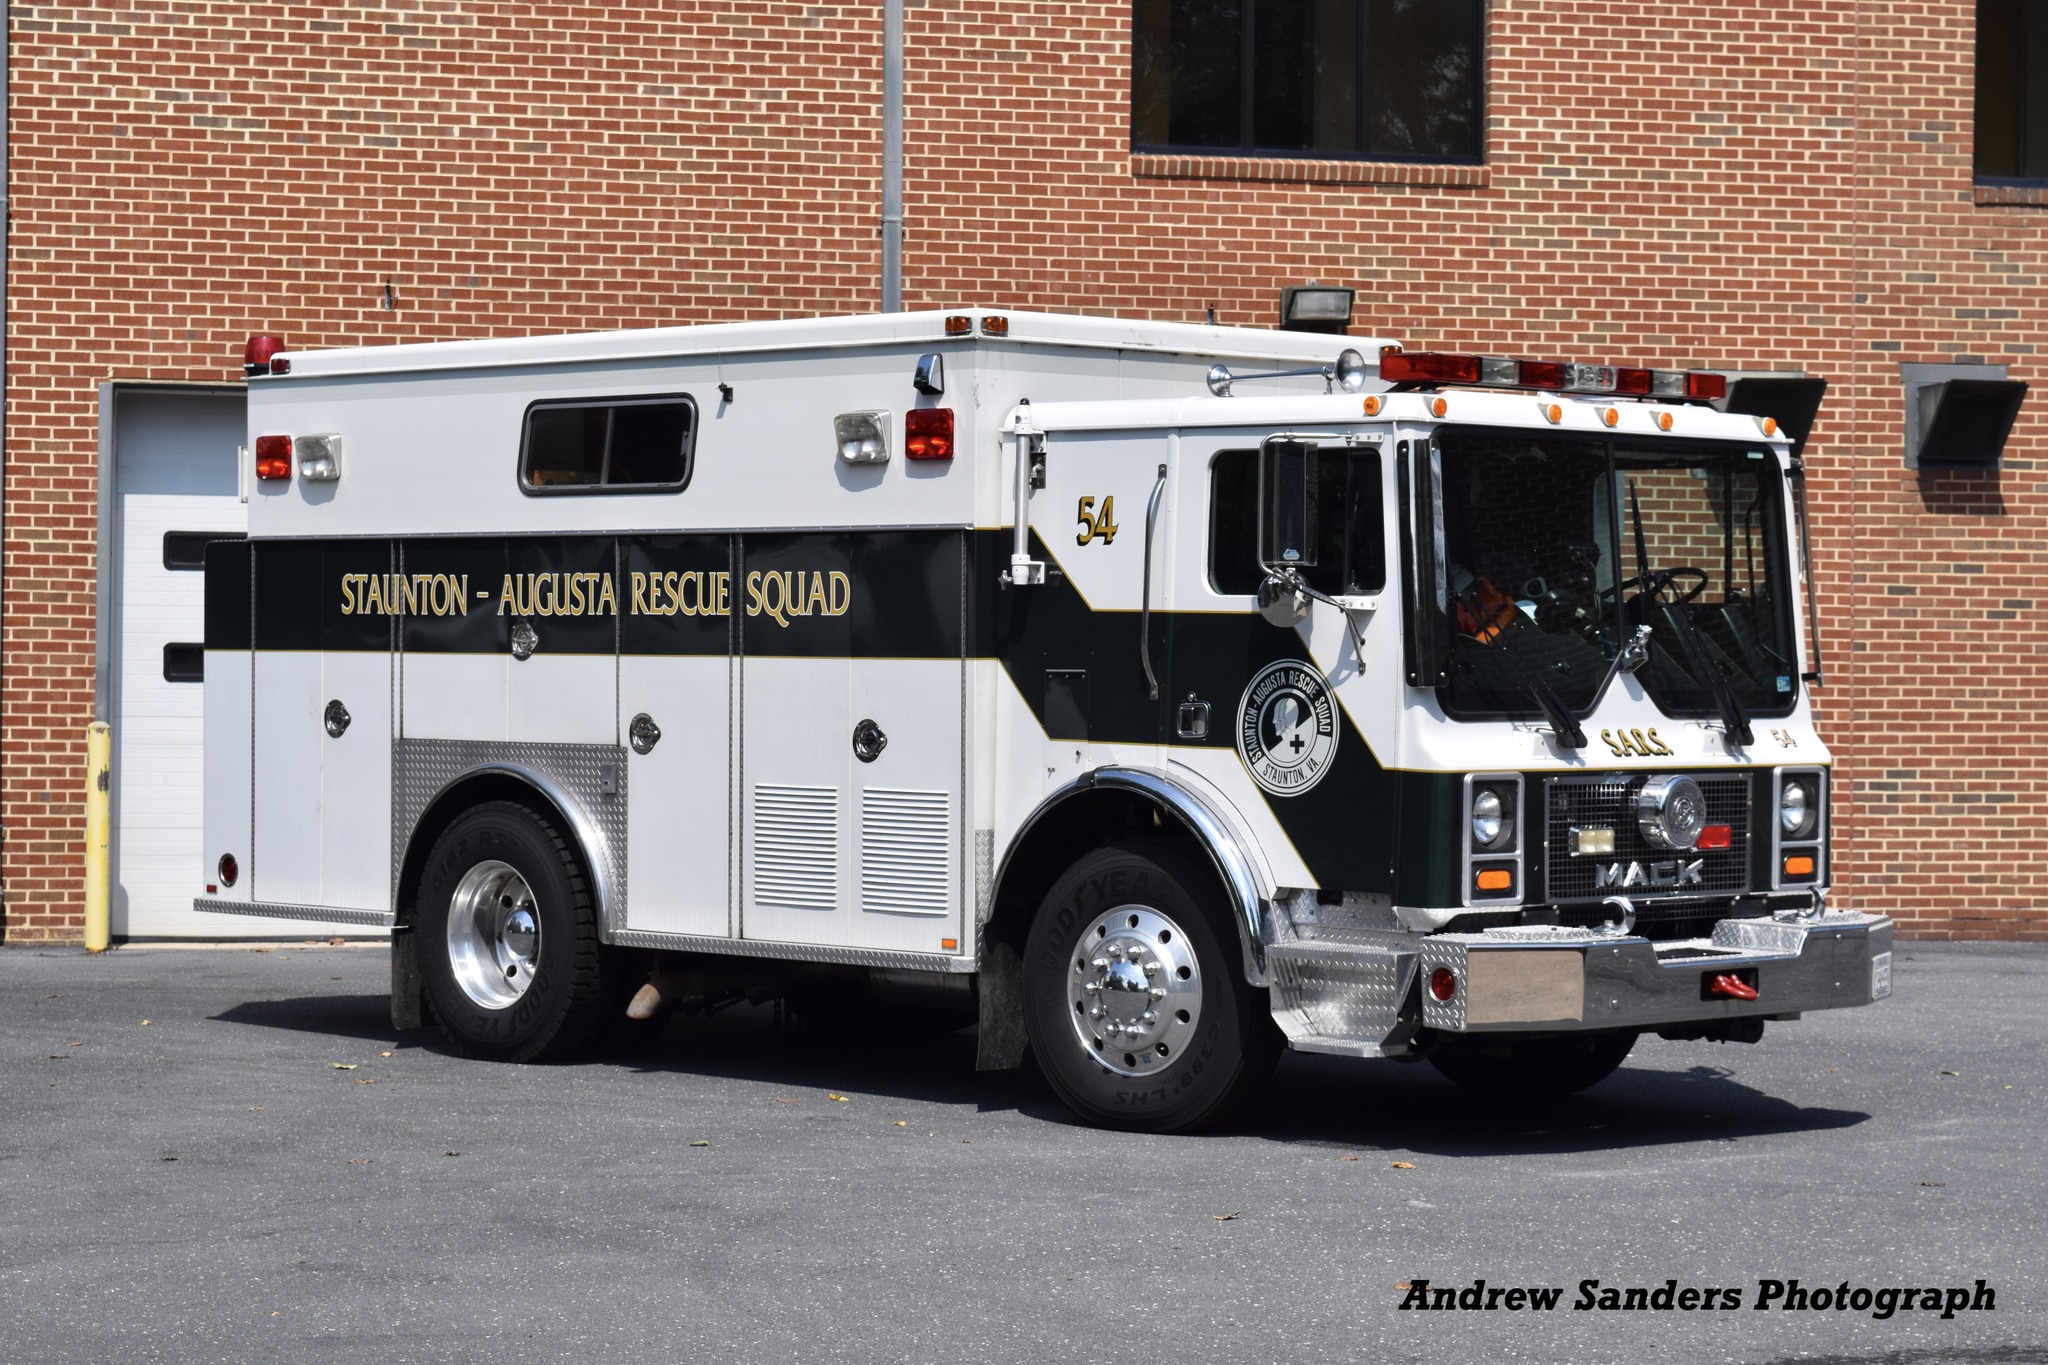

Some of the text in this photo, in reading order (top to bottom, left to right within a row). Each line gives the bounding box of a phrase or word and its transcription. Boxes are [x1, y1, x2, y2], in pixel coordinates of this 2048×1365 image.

[1076, 496, 1119, 546] 54
[341, 573, 468, 616] STAUNTON
[497, 572, 617, 616] AUGUSTA
[631, 571, 730, 616] RESCUE
[746, 570, 851, 628] SQUAD
[1288, 670, 1320, 699] RESCUE
[1314, 696, 1331, 733] SQUAD
[1769, 729, 1798, 749] 54
[1305, 757, 1322, 773] VA.
[1595, 859, 1704, 888] MACK
[1113, 1087, 1167, 1106] LHS
